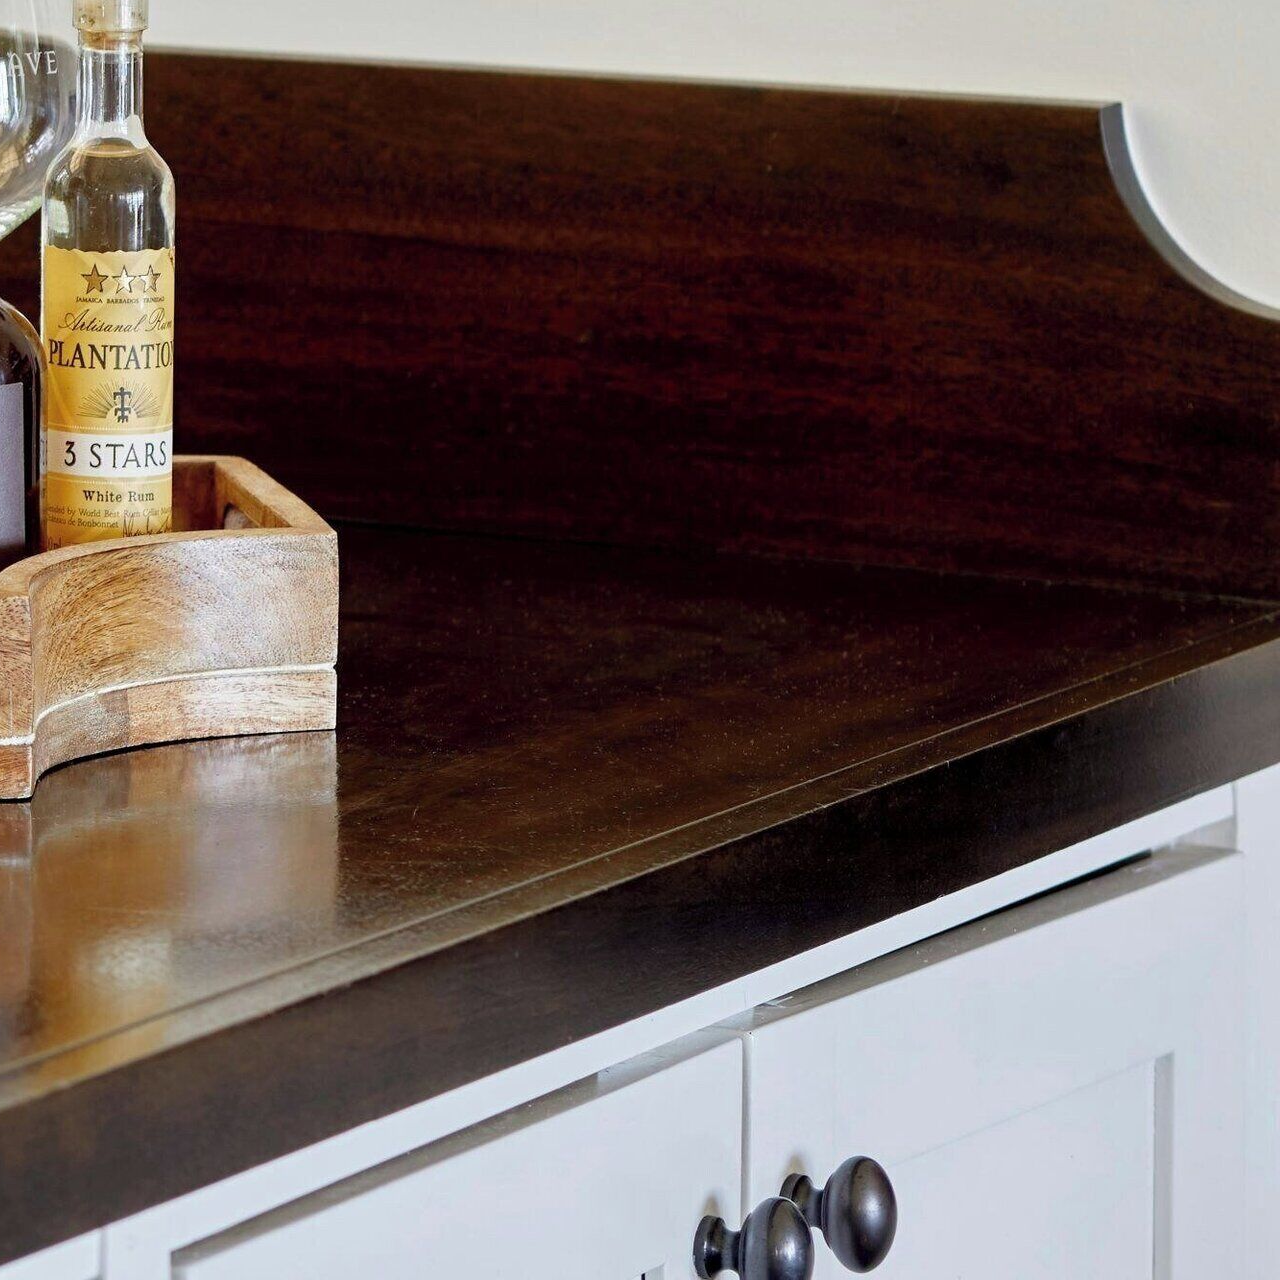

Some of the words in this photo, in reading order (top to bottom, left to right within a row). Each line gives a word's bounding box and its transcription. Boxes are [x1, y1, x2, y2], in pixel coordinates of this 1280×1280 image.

[57, 308, 148, 332] Artisanal
[64, 440, 76, 466] 3
[89, 440, 167, 469] STARS
[83, 490, 122, 502] White
[128, 490, 155, 501] Rum
